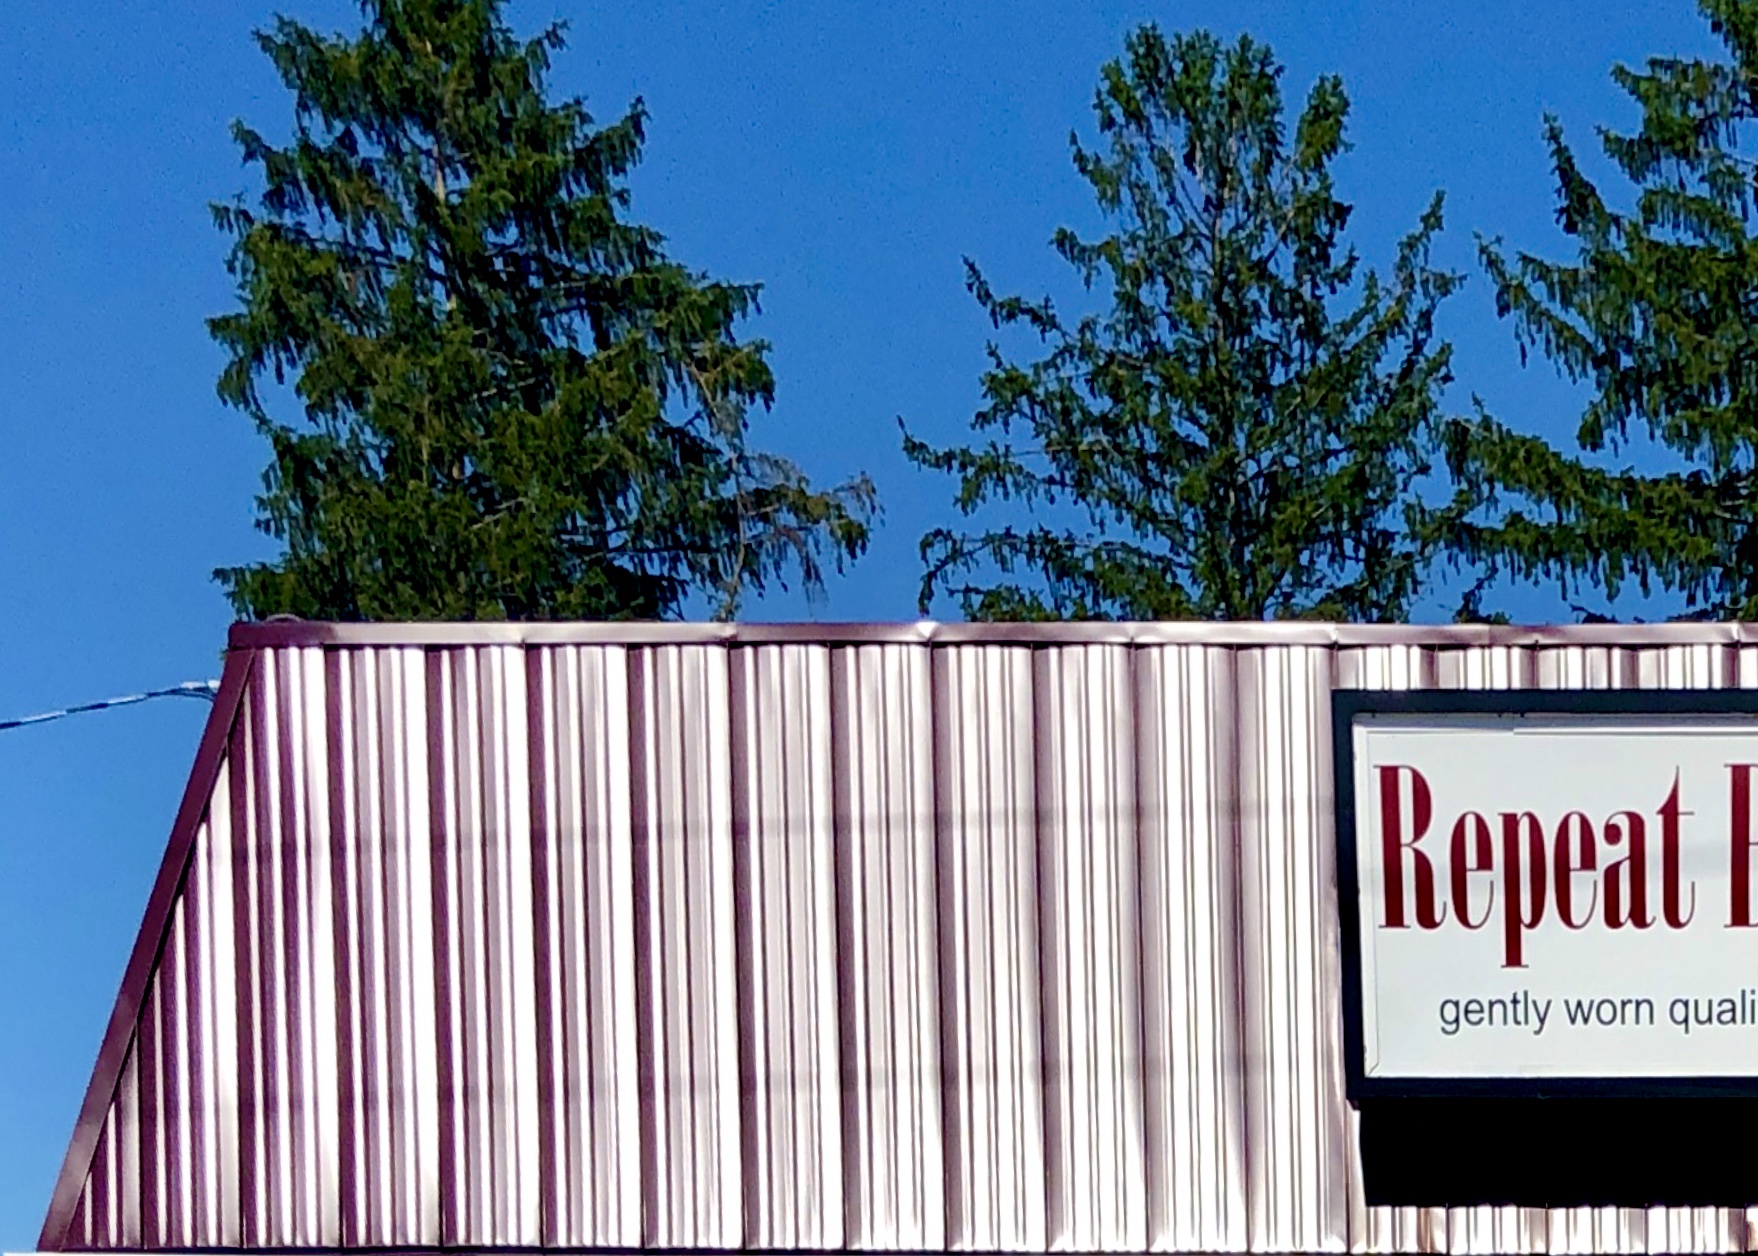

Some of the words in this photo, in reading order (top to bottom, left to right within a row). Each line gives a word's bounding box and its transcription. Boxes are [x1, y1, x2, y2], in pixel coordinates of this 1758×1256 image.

[1374, 765, 1695, 968] Repeat
[1440, 990, 1552, 1035] gently
[1564, 999, 1653, 1025] worn
